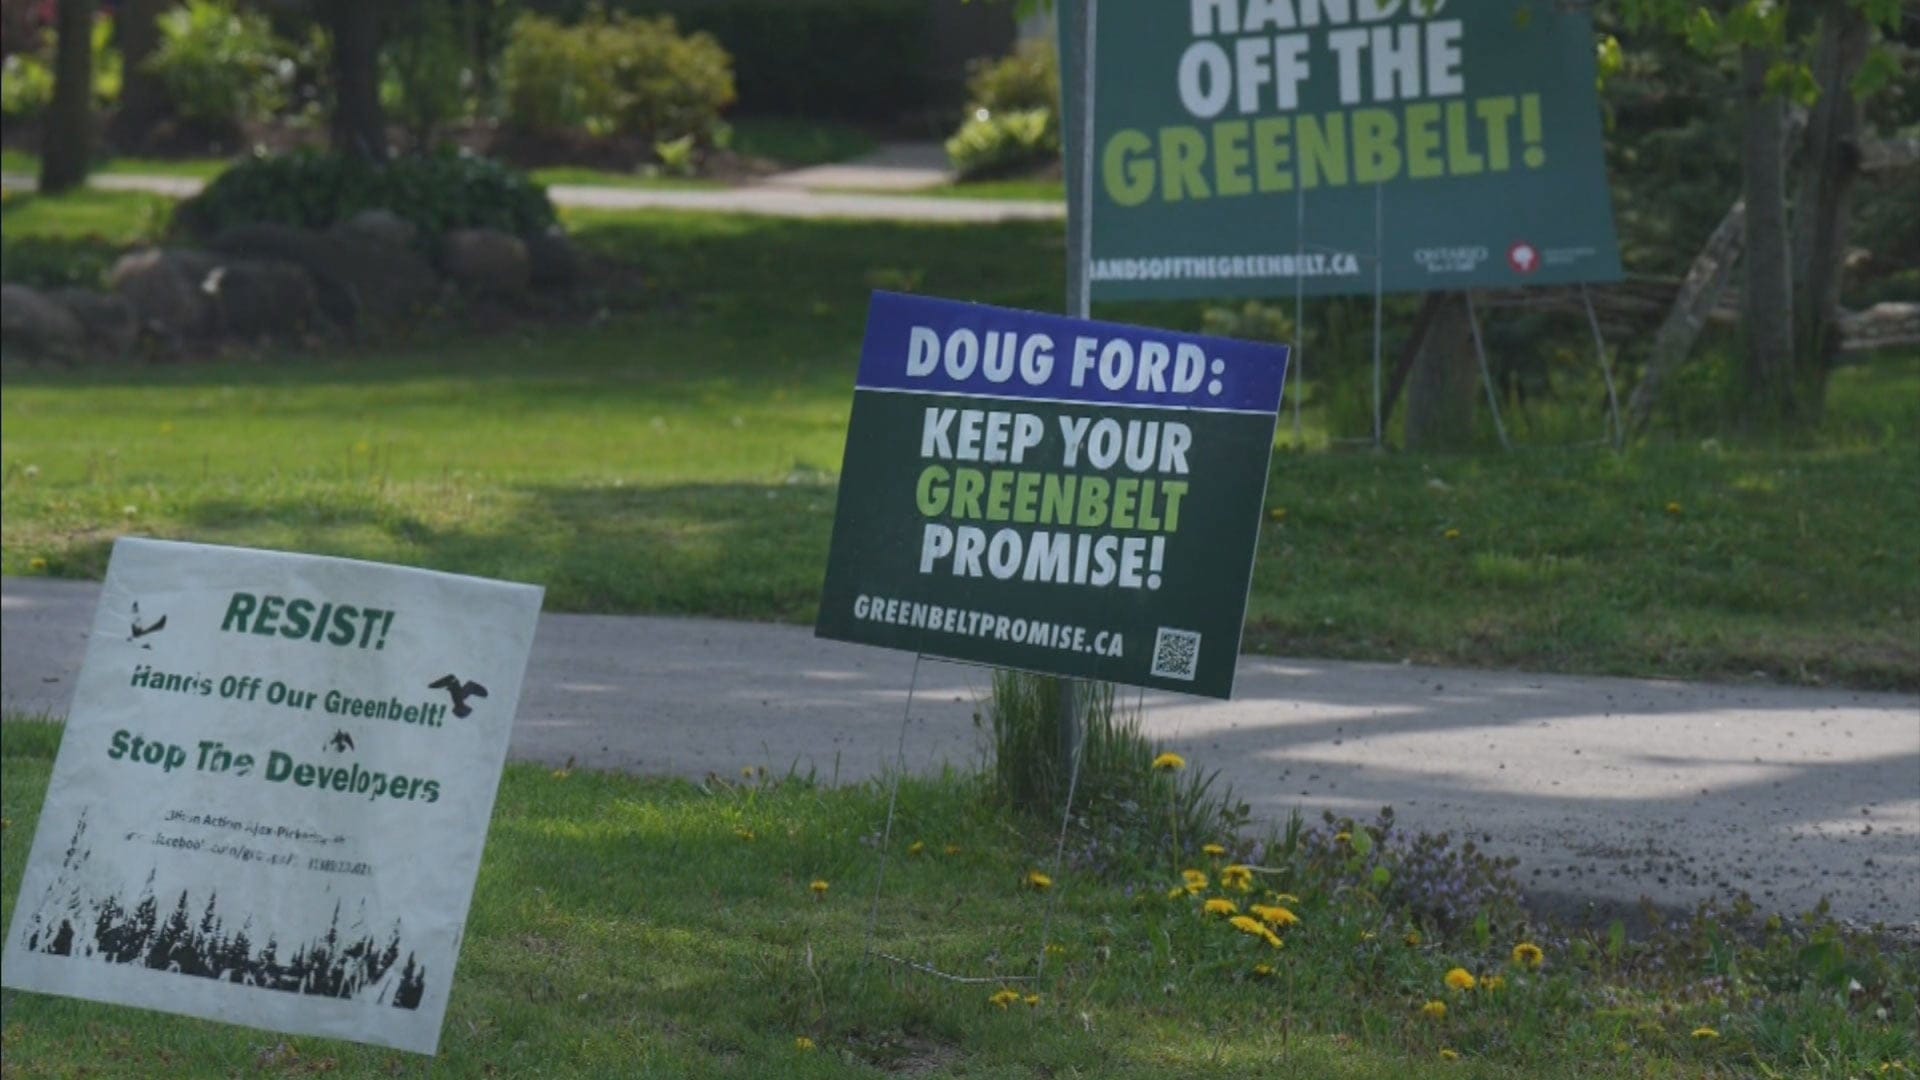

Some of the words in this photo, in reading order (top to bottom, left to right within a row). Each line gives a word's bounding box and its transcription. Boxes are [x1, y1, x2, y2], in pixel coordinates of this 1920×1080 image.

[1178, 34, 1312, 118] OFF
[1329, 20, 1464, 104] THE
[1102, 93, 1545, 206] GREENBELT!
[906, 326, 1055, 386] DOUG
[1070, 336, 1225, 396] FORD:
[920, 407, 1044, 464] KEEP
[1058, 414, 1192, 474] YOUR
[916, 465, 1189, 532] GREENBELT
[919, 523, 1166, 590] PROMISE!
[220, 592, 395, 651] RESIST!
[853, 594, 1125, 658] GREENBELTPROMISE.CA
[220, 675, 262, 700] Off
[266, 681, 317, 710] Our
[324, 689, 446, 728] Greenbelt!
[108, 729, 186, 772] Stop
[265, 750, 440, 803] Developers
